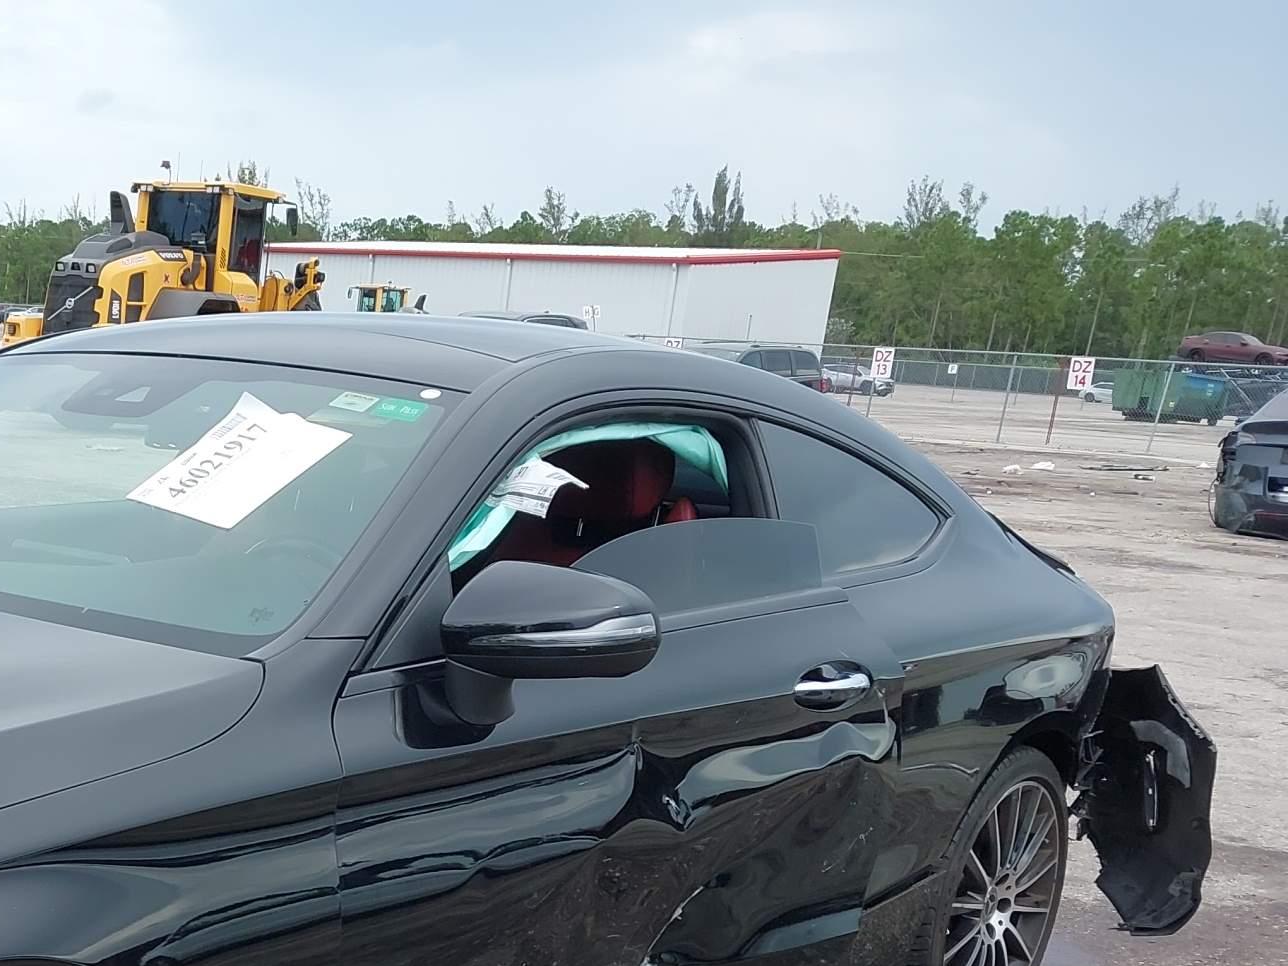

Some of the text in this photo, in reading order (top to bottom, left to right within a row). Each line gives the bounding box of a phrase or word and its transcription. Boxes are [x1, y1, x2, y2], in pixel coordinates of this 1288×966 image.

[159, 251, 185, 260] VOLVO
[875, 350, 893, 362] DZ
[876, 363, 887, 375] 13
[1072, 360, 1093, 373] DZ
[1074, 374, 1087, 387] 14
[168, 423, 267, 498] 46021917
